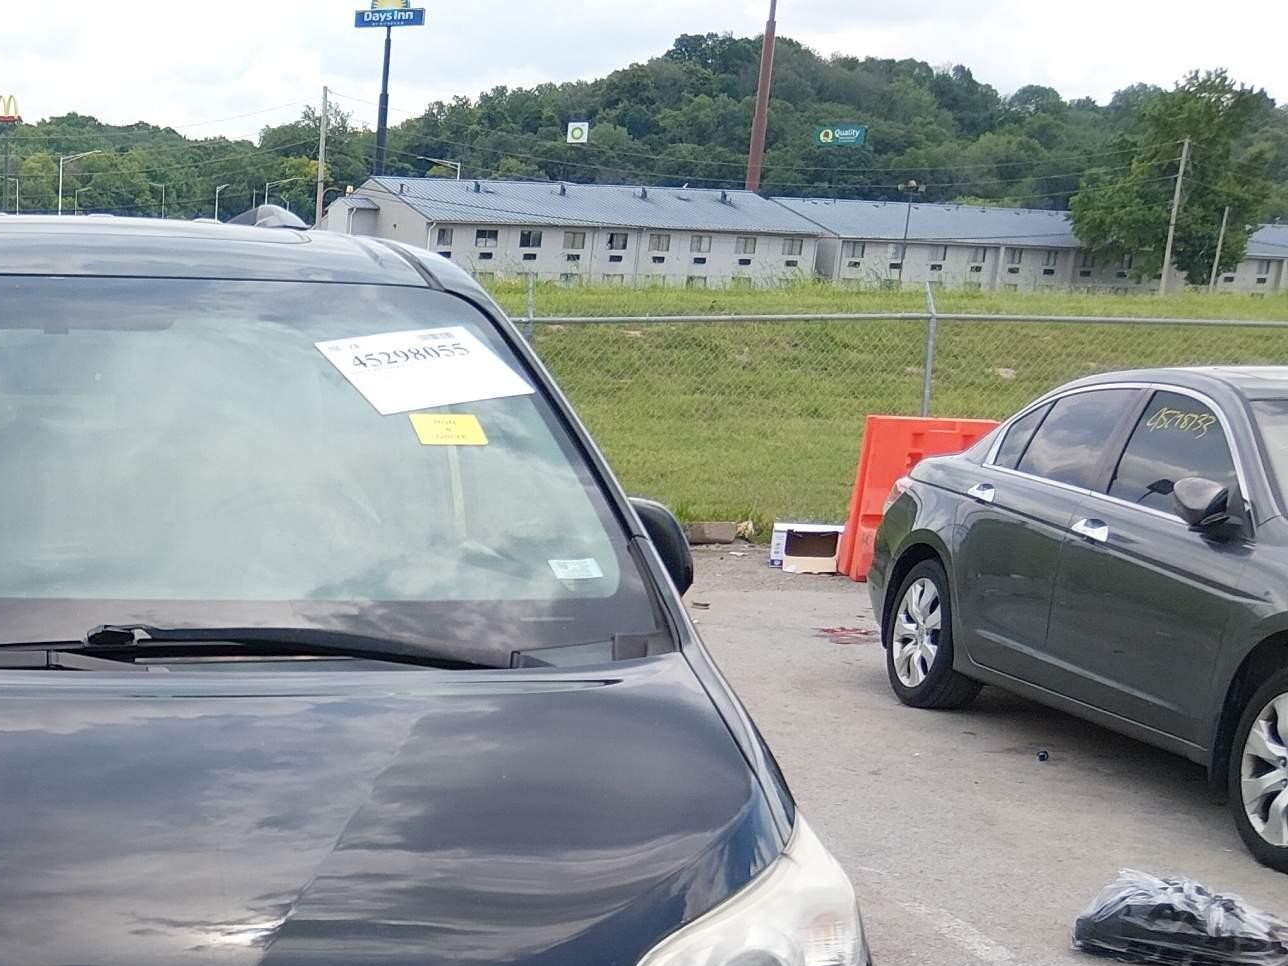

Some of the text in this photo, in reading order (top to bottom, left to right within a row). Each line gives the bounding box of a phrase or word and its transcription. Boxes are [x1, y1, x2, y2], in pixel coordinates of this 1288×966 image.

[363, 10, 414, 22] Days Inn
[834, 128, 861, 138] Quality
[352, 342, 470, 368] 45298055
